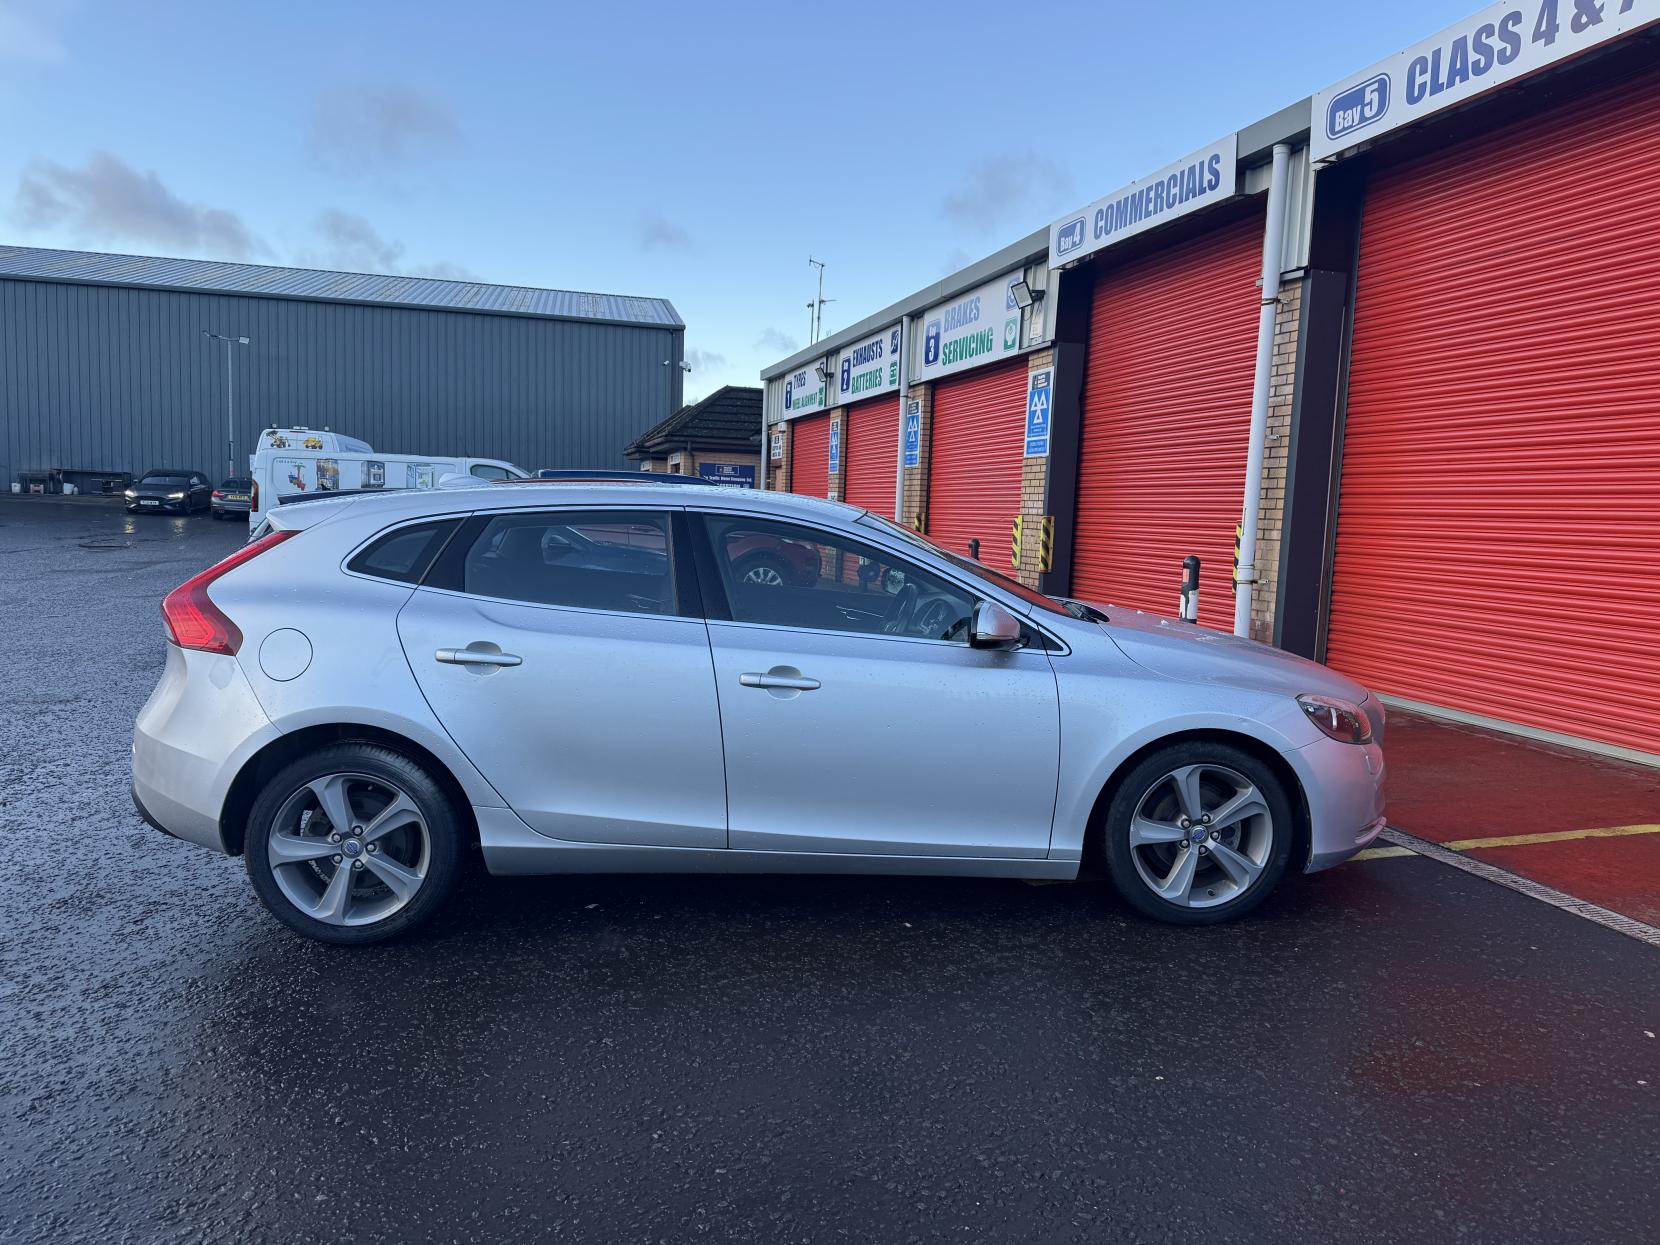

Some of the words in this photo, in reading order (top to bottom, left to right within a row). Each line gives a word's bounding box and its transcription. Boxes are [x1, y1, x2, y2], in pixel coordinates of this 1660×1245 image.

[1405, 10, 1523, 106] CLASS
[1531, 0, 1560, 48] 4
[1334, 104, 1362, 132] Bay
[1362, 82, 1380, 118] 5
[1093, 153, 1221, 241] COMMERCIALS
[1060, 235, 1073, 251] Bay
[1072, 221, 1082, 244] 4
[944, 296, 980, 332] BRAKES
[853, 339, 882, 367] EXHAUSTS
[929, 338, 934, 361] 3
[942, 326, 994, 366] SERVICING
[843, 371, 848, 390] 2
[852, 367, 882, 394] BATTERIES
